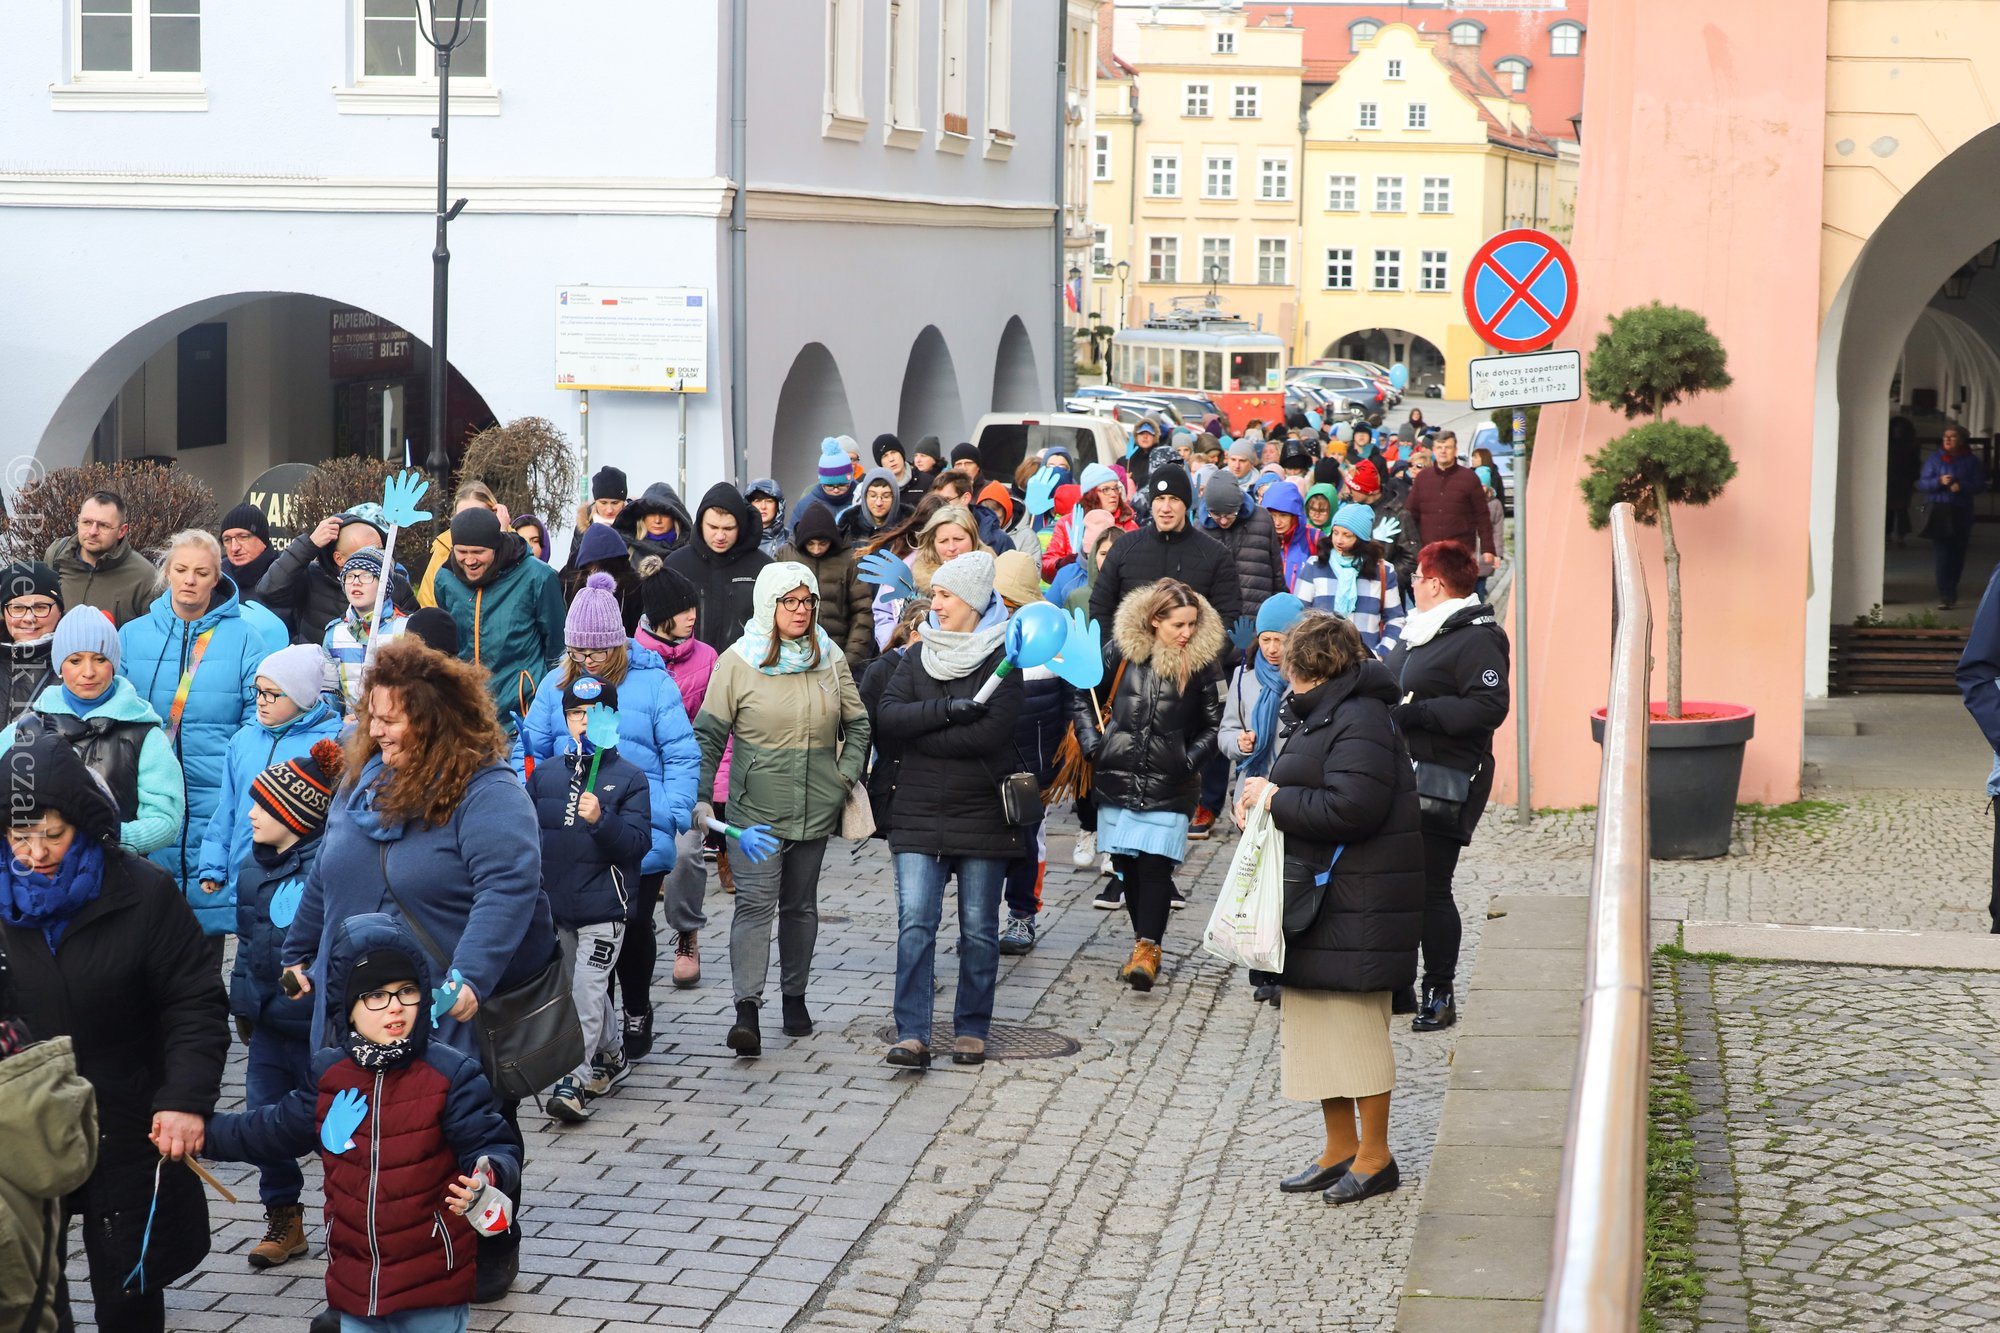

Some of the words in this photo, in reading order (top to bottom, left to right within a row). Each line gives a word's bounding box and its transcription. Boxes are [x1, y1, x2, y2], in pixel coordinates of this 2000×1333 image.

[1475, 370, 1489, 378] Nie
[1492, 367, 1522, 377] dotyczy
[1525, 363, 1575, 374] zaopatrzenia
[1498, 379, 1510, 387] do
[1530, 375, 1554, 384] d.m.c.
[1499, 387, 1521, 399] godz.
[1523, 386, 1539, 395] 6-11
[1546, 383, 1567, 393] 17-22
[574, 683, 601, 691] NASA
[289, 779, 328, 812] BOSS
